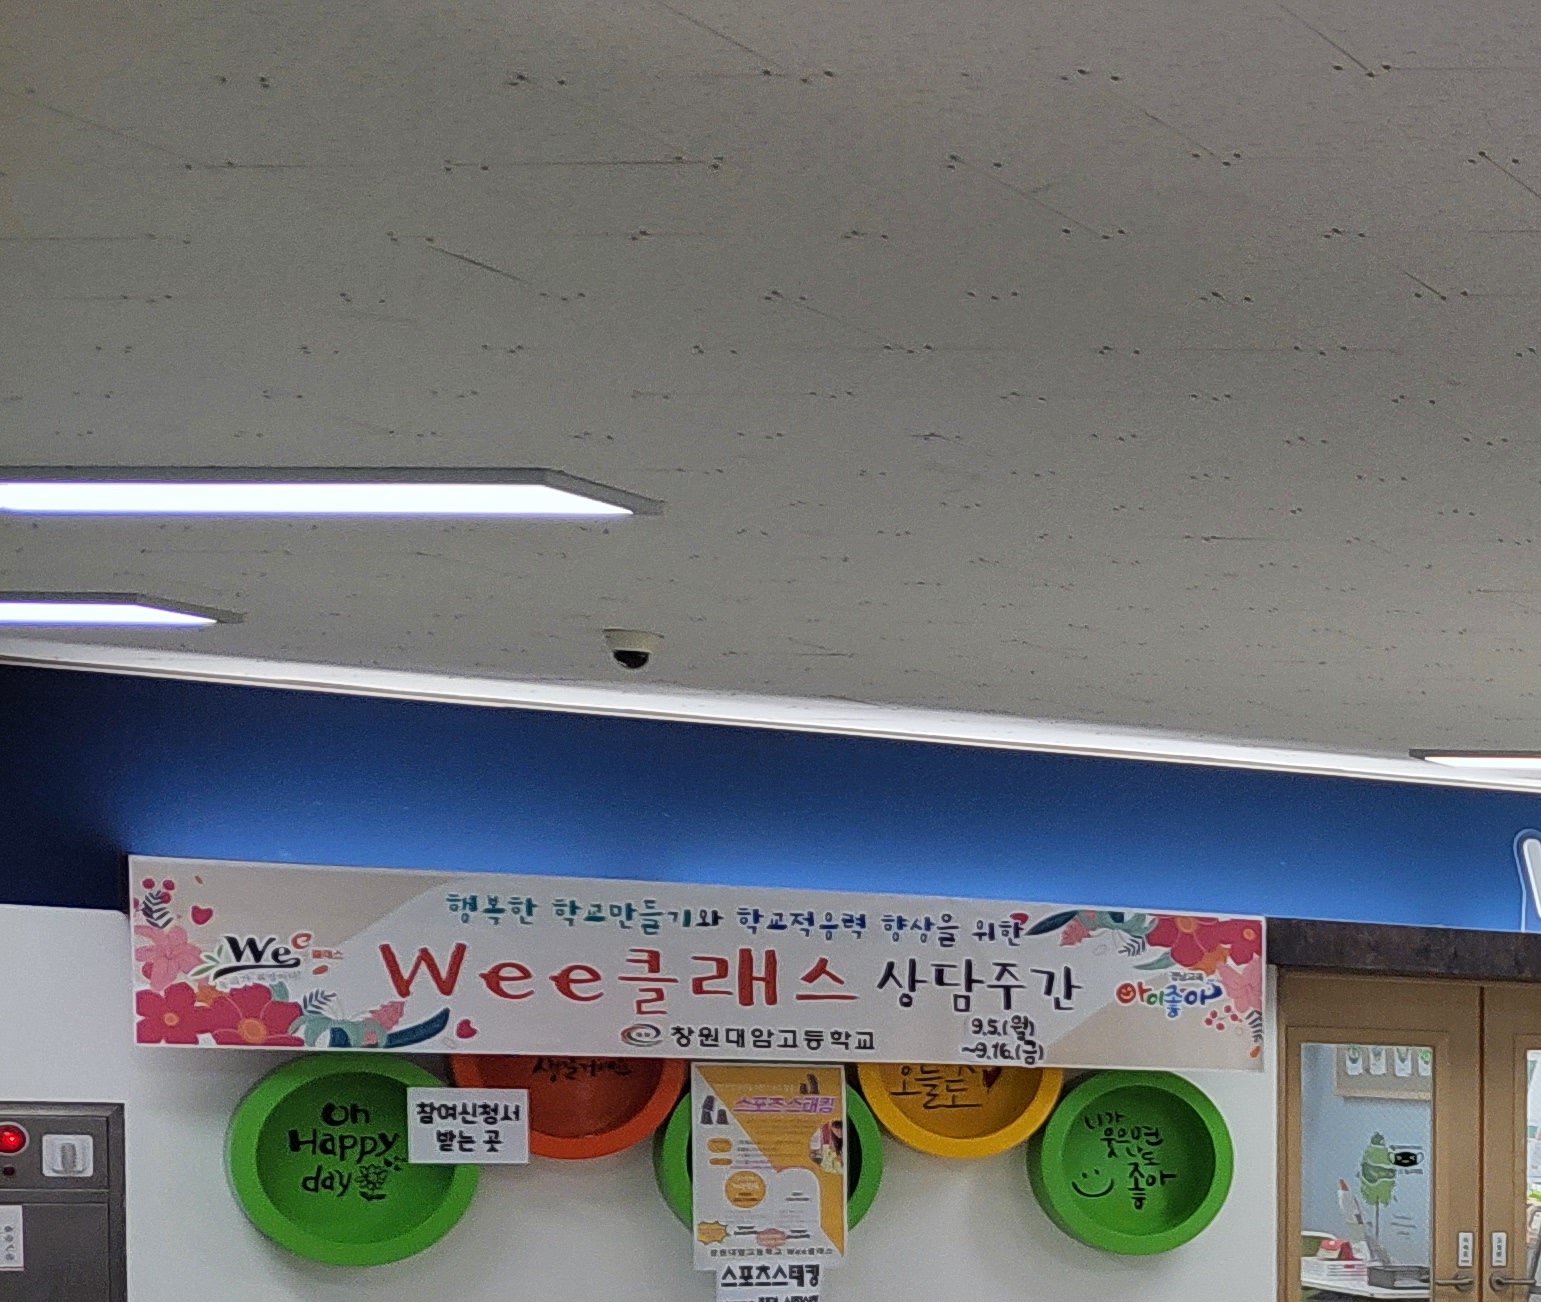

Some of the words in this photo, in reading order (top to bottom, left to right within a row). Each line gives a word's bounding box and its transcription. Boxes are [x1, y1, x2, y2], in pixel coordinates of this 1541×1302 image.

[446, 893, 539, 926] 행복한
[552, 899, 723, 936] 학교만들기와
[736, 905, 866, 942] 학교적응력
[881, 912, 960, 948] 향상을
[972, 917, 1024, 947] 위한
[378, 942, 859, 1016] Wee클래스
[877, 957, 1083, 1014] 상담주간
[670, 1024, 876, 1052] 창원대암고등학교
[971, 1014, 1036, 1040] 9.5.(월)
[415, 1100, 522, 1126] 참여신청서
[287, 1127, 401, 1164] Happy
[435, 1129, 477, 1153] 받는
[482, 1130, 504, 1154] 곳
[301, 1164, 353, 1197] day
[1127, 1162, 1178, 1212] 좋아
